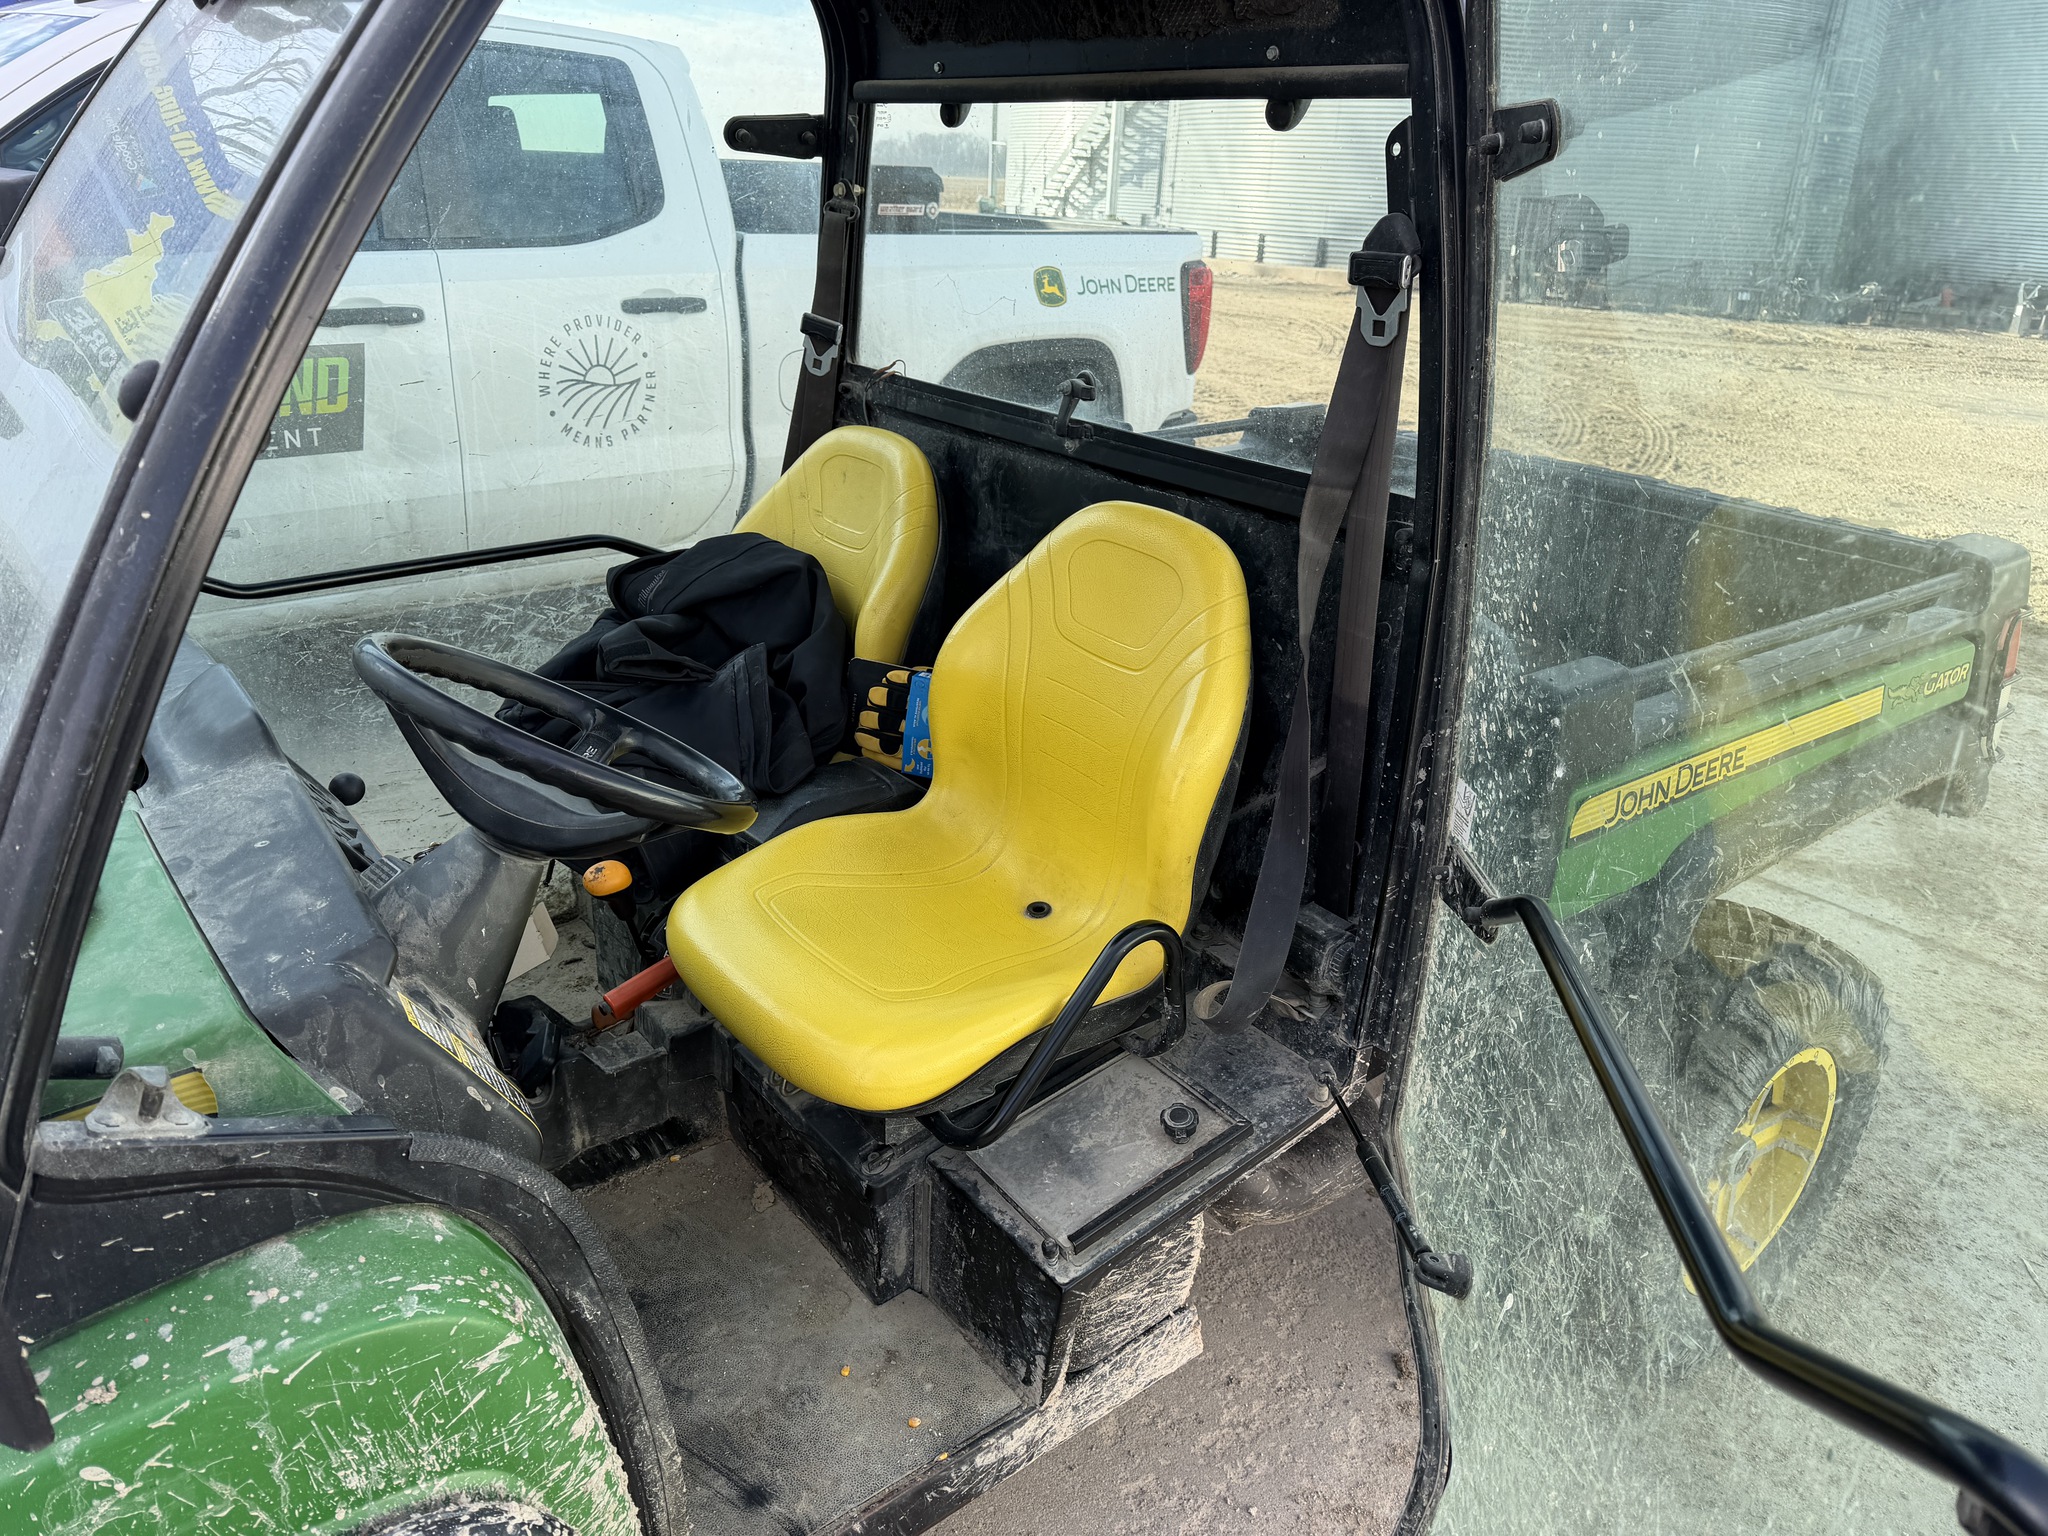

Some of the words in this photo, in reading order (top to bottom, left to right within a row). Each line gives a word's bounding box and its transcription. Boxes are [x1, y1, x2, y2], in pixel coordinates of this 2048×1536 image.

[1077, 275, 1122, 295] JOHN
[1124, 274, 1176, 293] DEERE
[538, 336, 562, 397] WHERE
[563, 314, 642, 345] PROVIDER
[560, 422, 614, 448] MEANS
[620, 370, 657, 441] PARTNER
[637, 569, 666, 608] Milwaukee
[1923, 662, 1970, 697] GATOR
[1604, 775, 1672, 827] JOHN
[1674, 745, 1748, 797] DEERE
